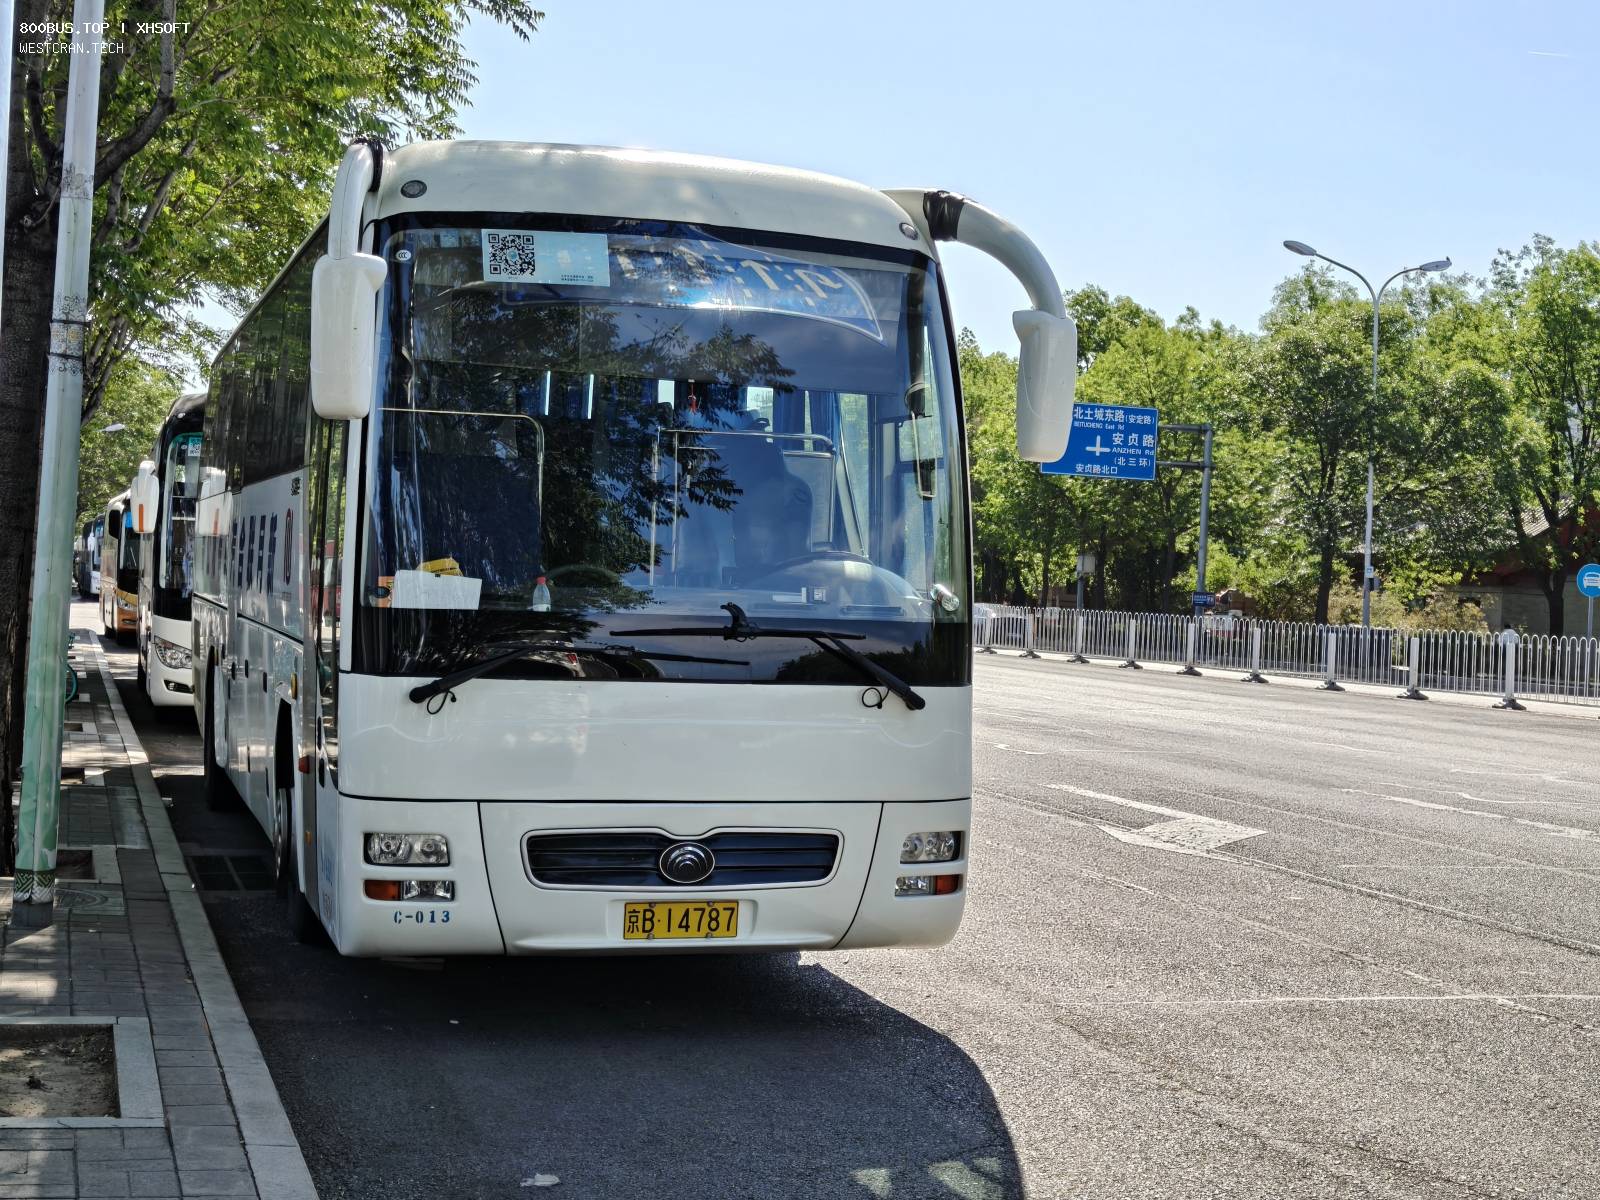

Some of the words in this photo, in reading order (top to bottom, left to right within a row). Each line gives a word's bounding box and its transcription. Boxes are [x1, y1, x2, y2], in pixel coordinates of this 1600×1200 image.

[1112, 432, 1154, 447] 安贞路
[1112, 447, 1142, 455] ANZHEN
[394, 910, 450, 924] C-013
